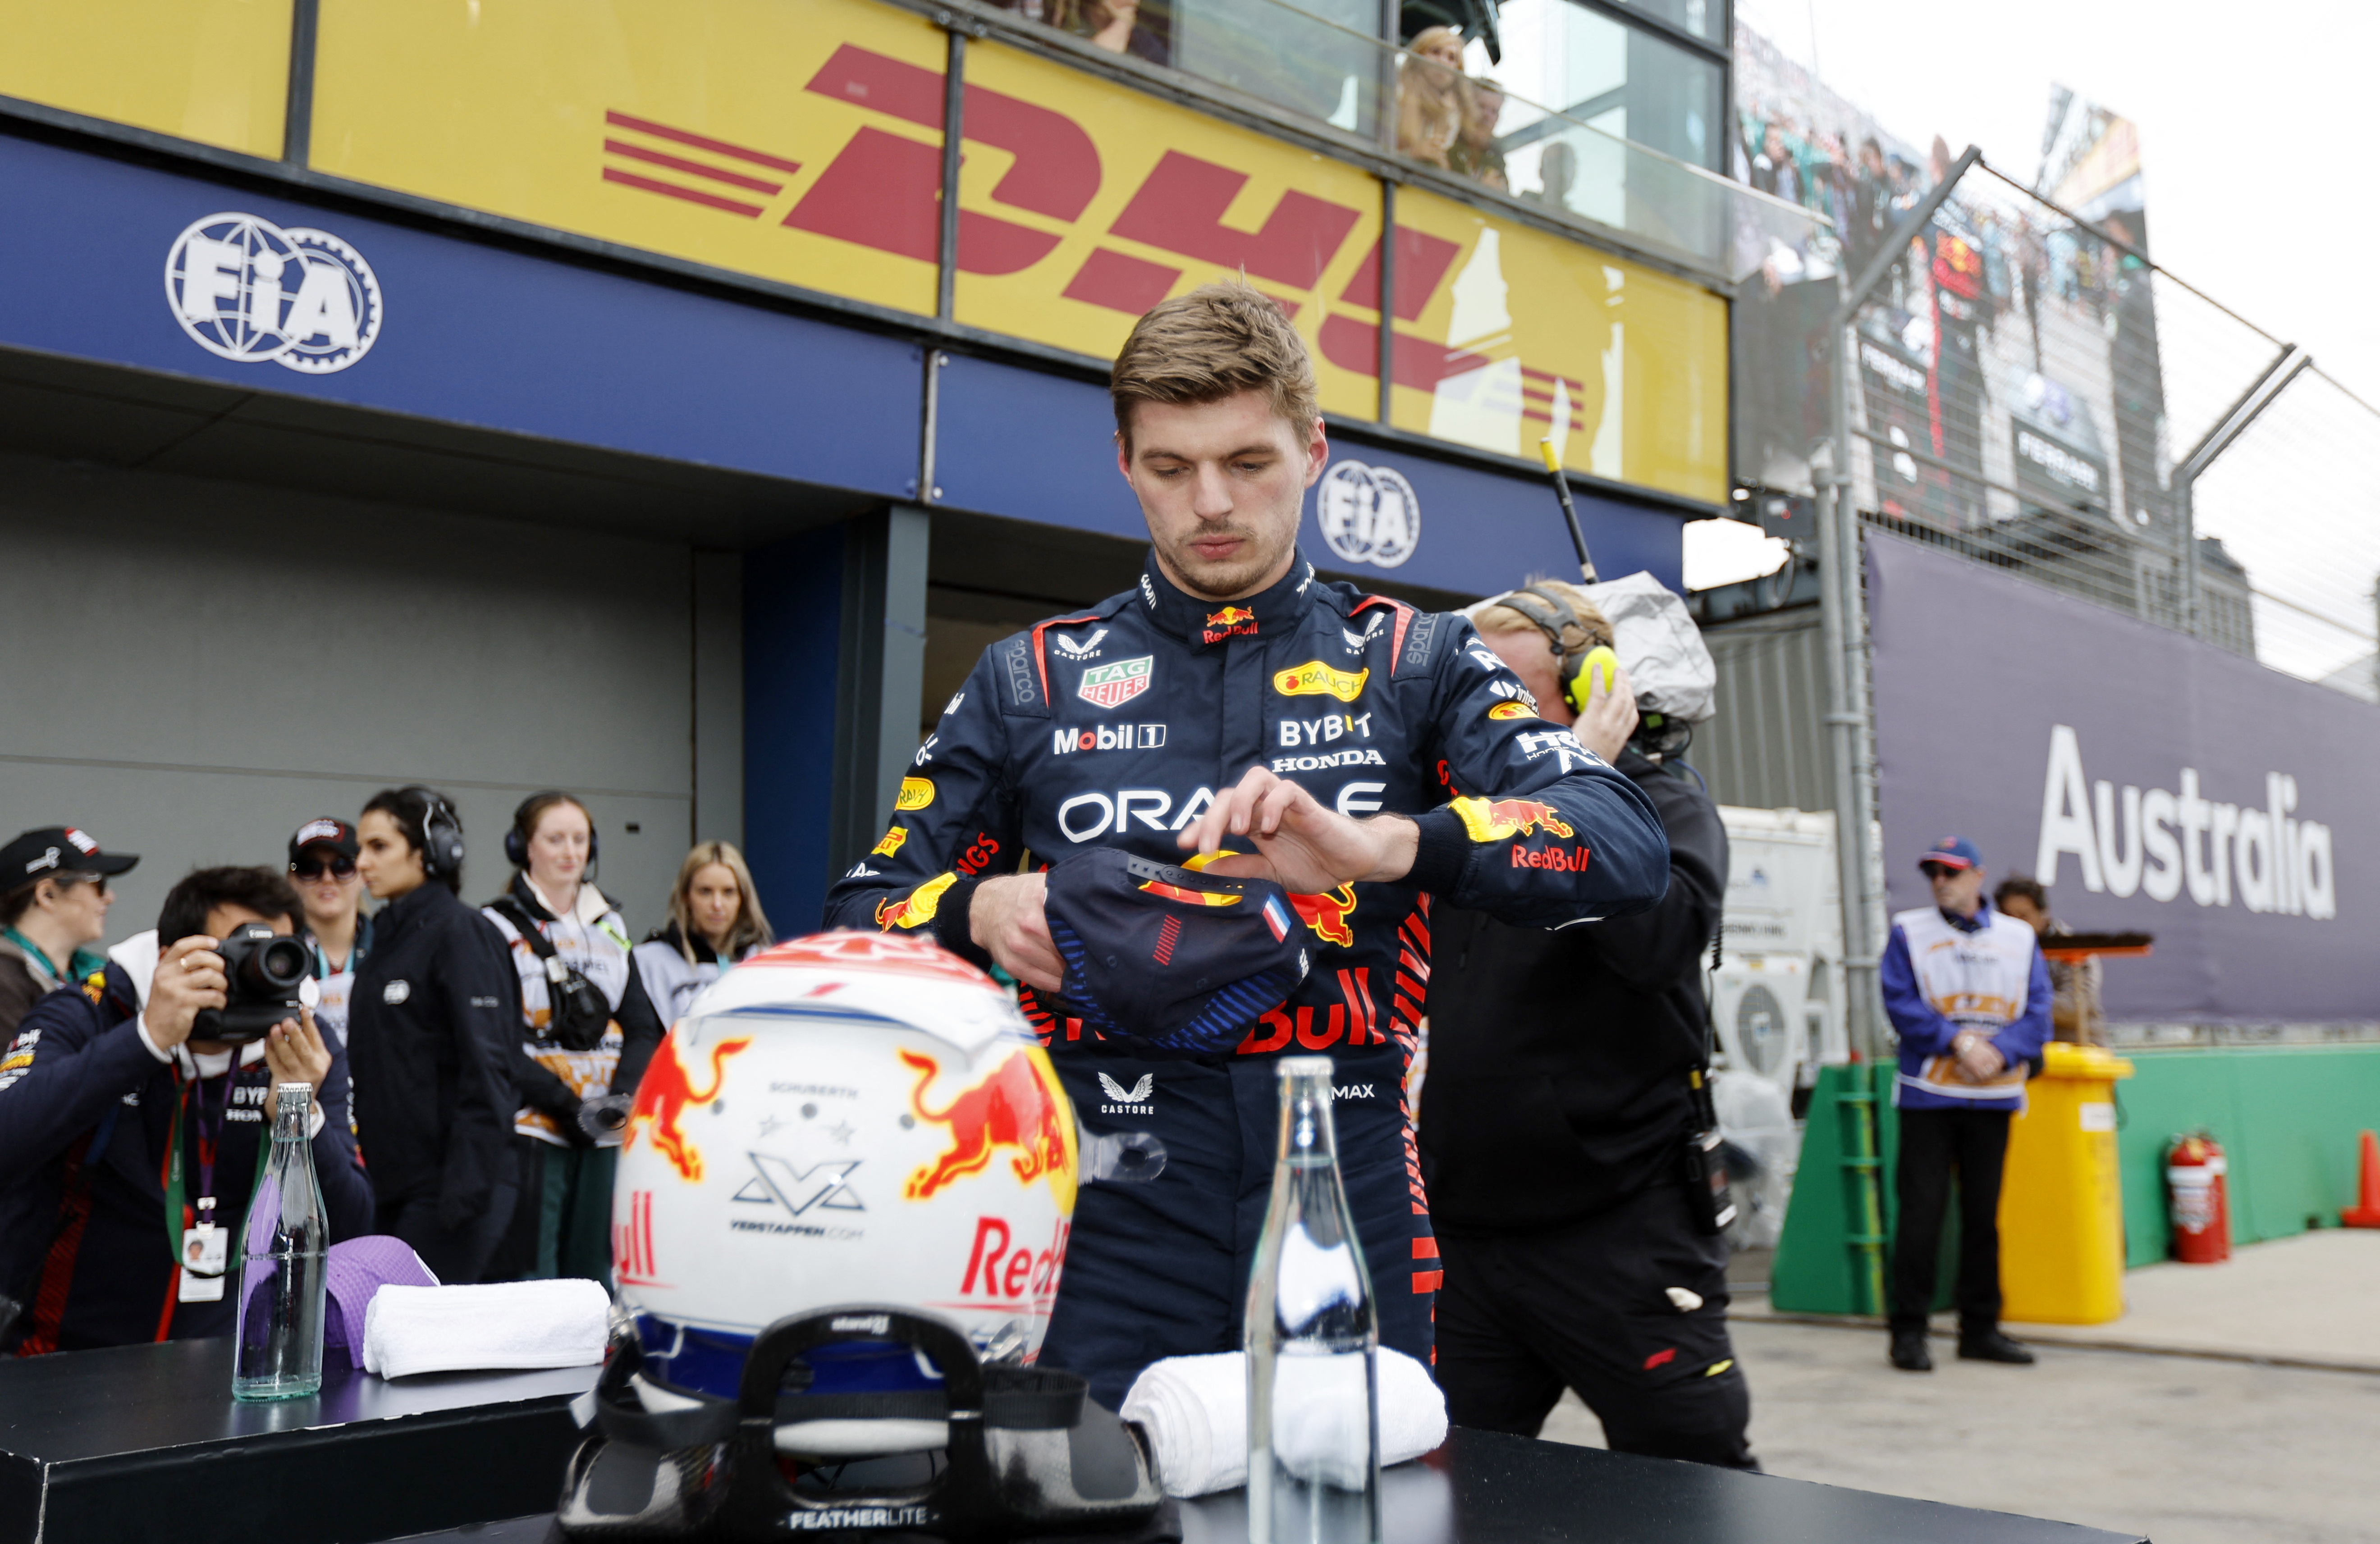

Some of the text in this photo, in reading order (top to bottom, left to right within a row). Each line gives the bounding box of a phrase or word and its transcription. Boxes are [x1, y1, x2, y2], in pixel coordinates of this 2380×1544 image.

[780, 41, 1490, 401] DHL
[1346, 629, 1384, 655] CASORE
[1054, 649, 1101, 661] CASTORE
[1005, 639, 1035, 703] sparco
[1091, 662, 1146, 683] TAG
[1301, 671, 1363, 693] RAUCH
[1084, 676, 1146, 703] HEUER
[1054, 725, 1132, 755] Mobil
[1281, 712, 1371, 746] BYBIT
[1272, 749, 1387, 773] HONDA
[1058, 782, 1387, 844] ORAE
[2035, 724, 2337, 920] Australia
[233, 1086, 269, 1105] BYB
[768, 1082, 858, 1100] SCHUBERTH
[1331, 1083, 1375, 1101] MAX
[226, 1108, 263, 1122] HON
[1101, 1105, 1154, 1115] CASTORE
[790, 1506, 928, 1530] FEATHERLITE
